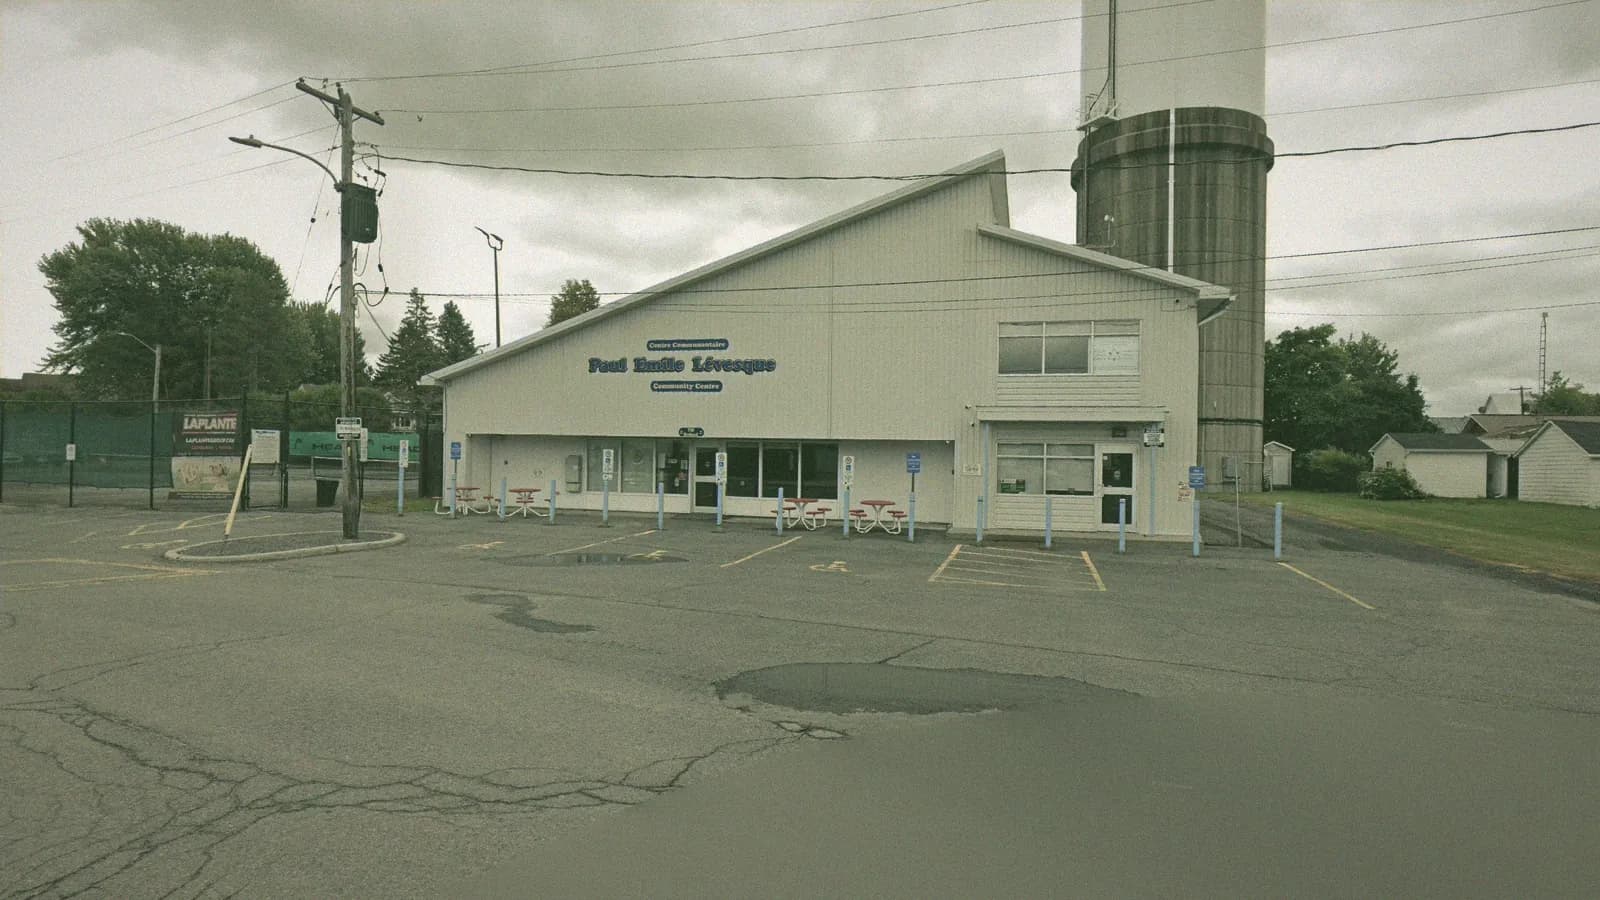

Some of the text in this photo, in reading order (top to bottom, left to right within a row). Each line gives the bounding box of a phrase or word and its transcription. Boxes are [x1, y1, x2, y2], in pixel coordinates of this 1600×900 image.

[588, 357, 628, 373] Paul
[692, 355, 776, 375] Lévesque
[653, 384, 694, 392] Community
[183, 417, 237, 430] LAPLANTE
